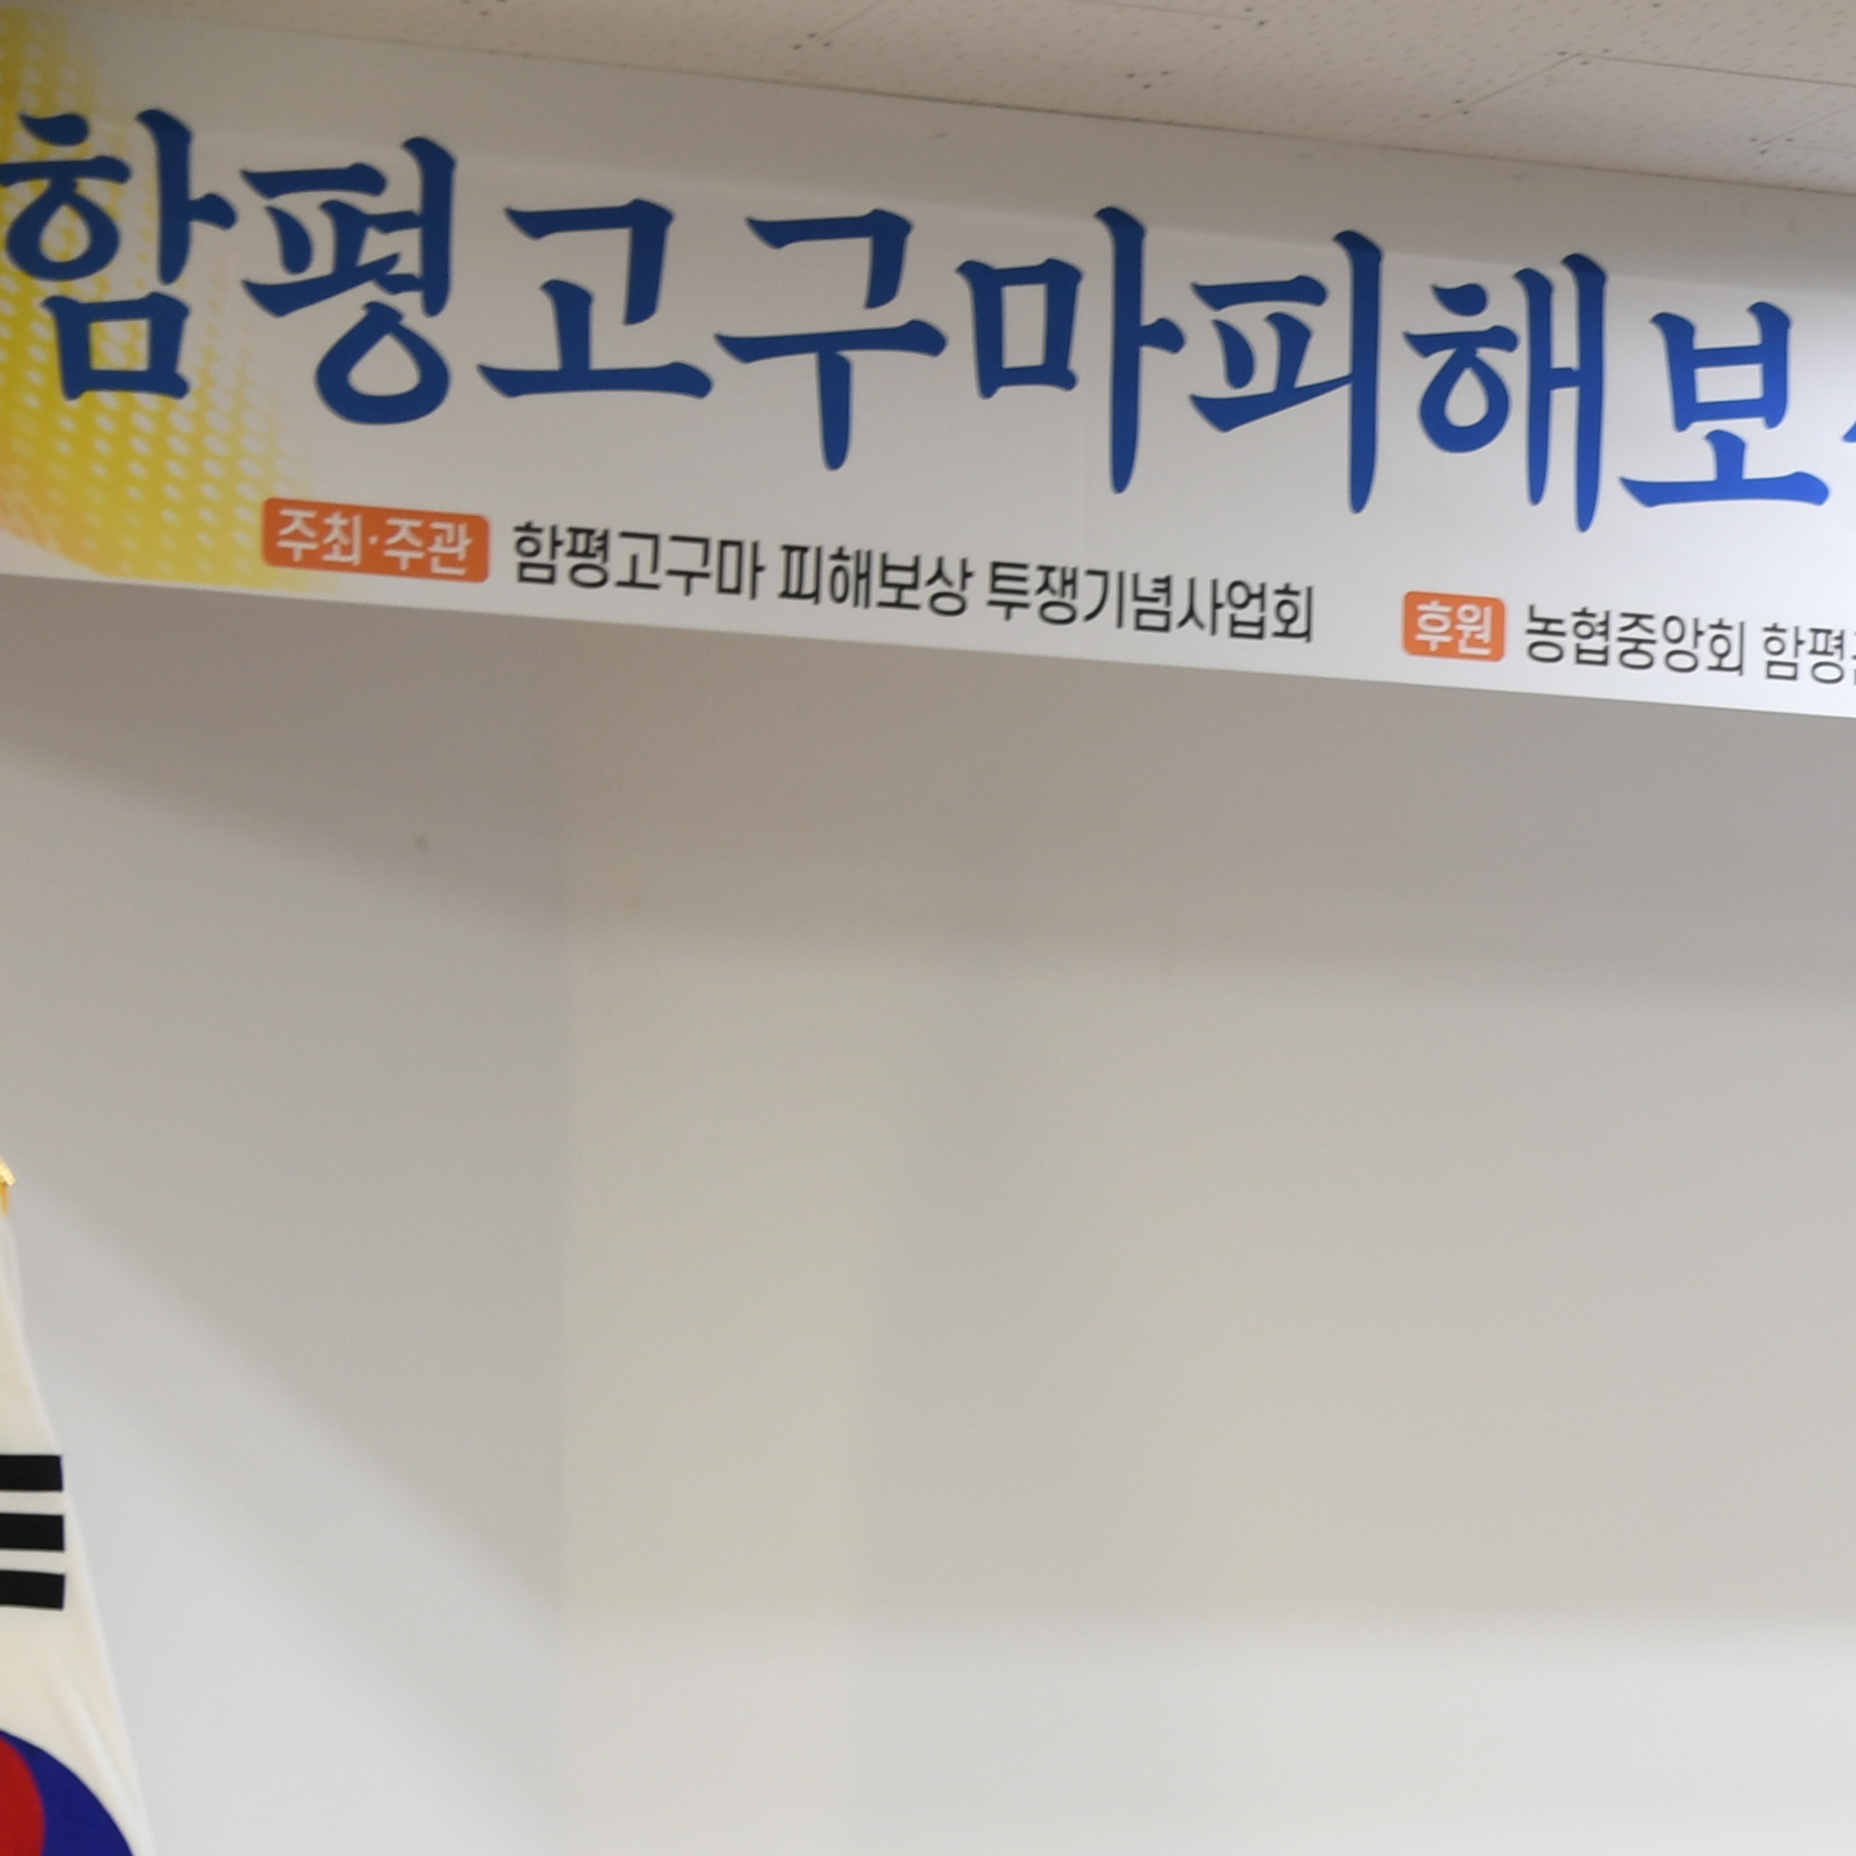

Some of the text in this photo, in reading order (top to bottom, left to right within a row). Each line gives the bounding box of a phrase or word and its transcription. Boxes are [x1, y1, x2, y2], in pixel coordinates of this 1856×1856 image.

[513, 520, 766, 600] 함평고구마
[777, 543, 975, 618] 피해보상
[986, 560, 1316, 643] 투쟁기념사업회
[1414, 600, 1492, 657] 후원
[1524, 604, 1746, 678] 농협중앙회
